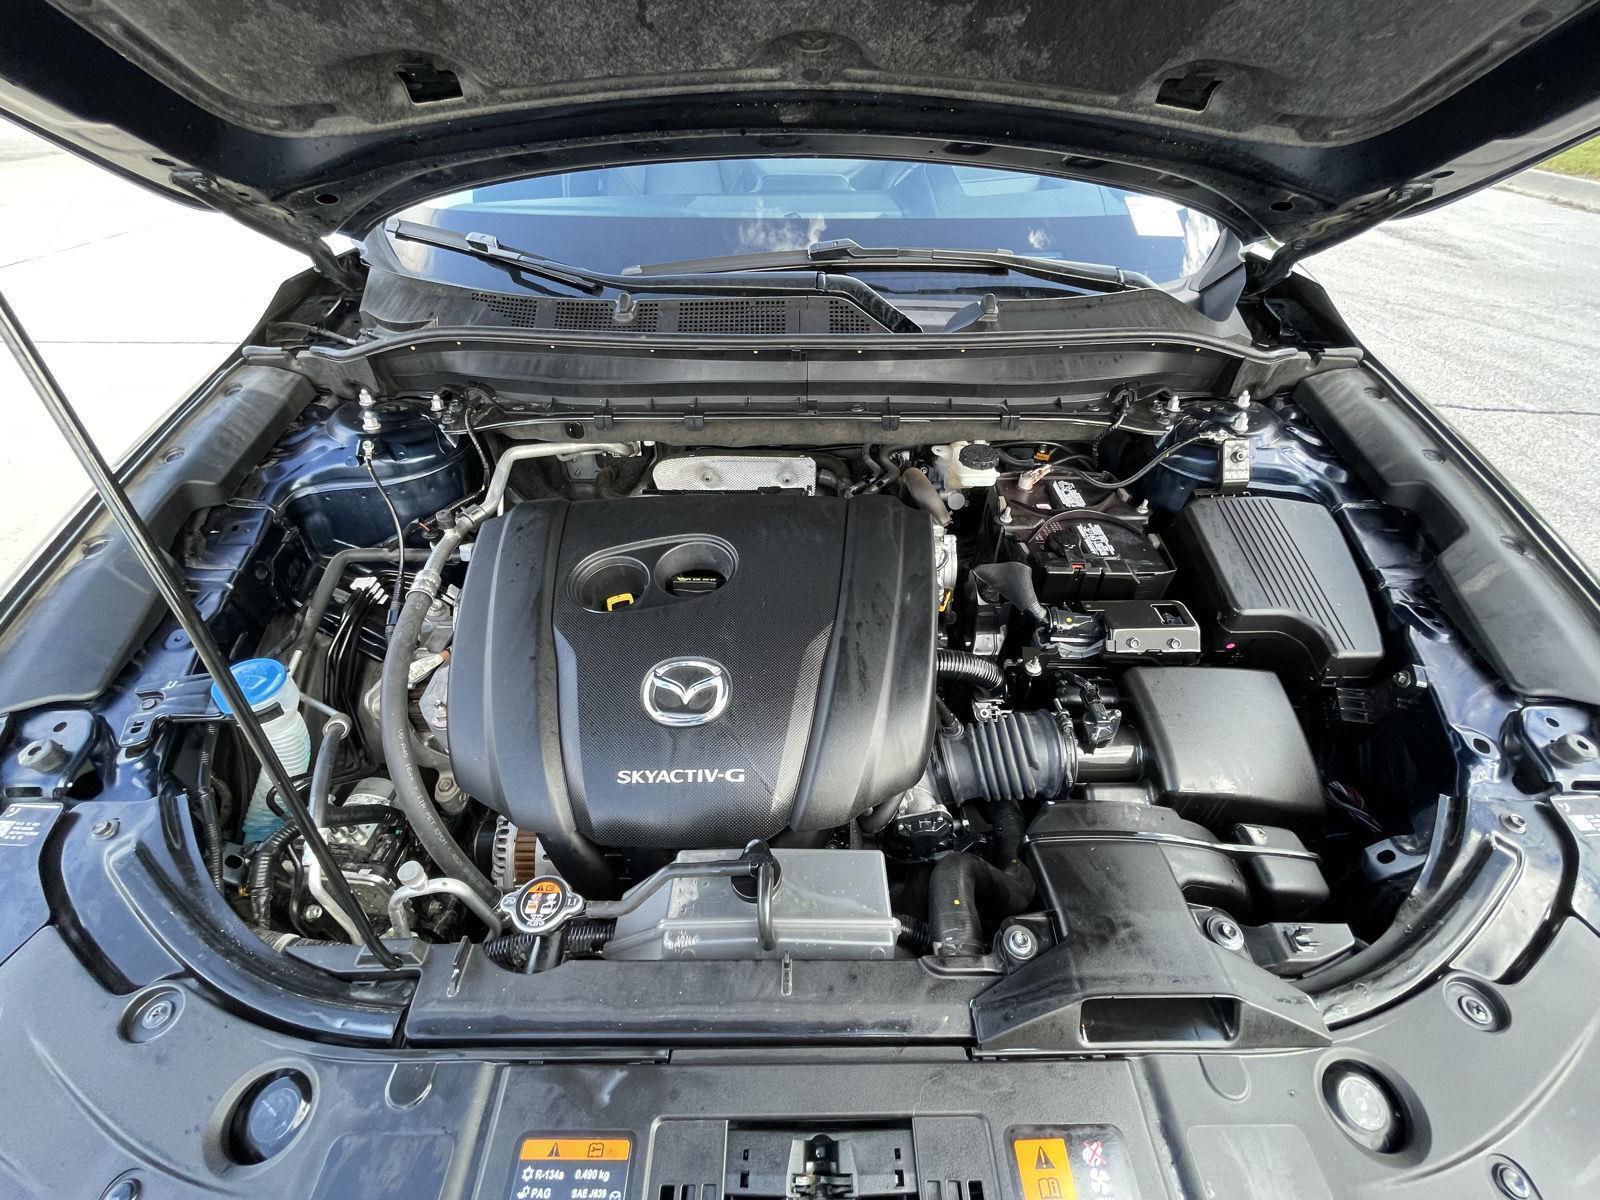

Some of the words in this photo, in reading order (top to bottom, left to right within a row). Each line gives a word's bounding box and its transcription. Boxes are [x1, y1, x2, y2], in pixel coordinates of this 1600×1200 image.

[616, 768, 745, 784] SKYACTIV-G
[534, 1168, 565, 1180] R-134a
[599, 1168, 610, 1182] kg
[530, 1187, 552, 1199] PAG
[571, 1188, 588, 1199] SAE
[588, 1188, 607, 1199] J639
